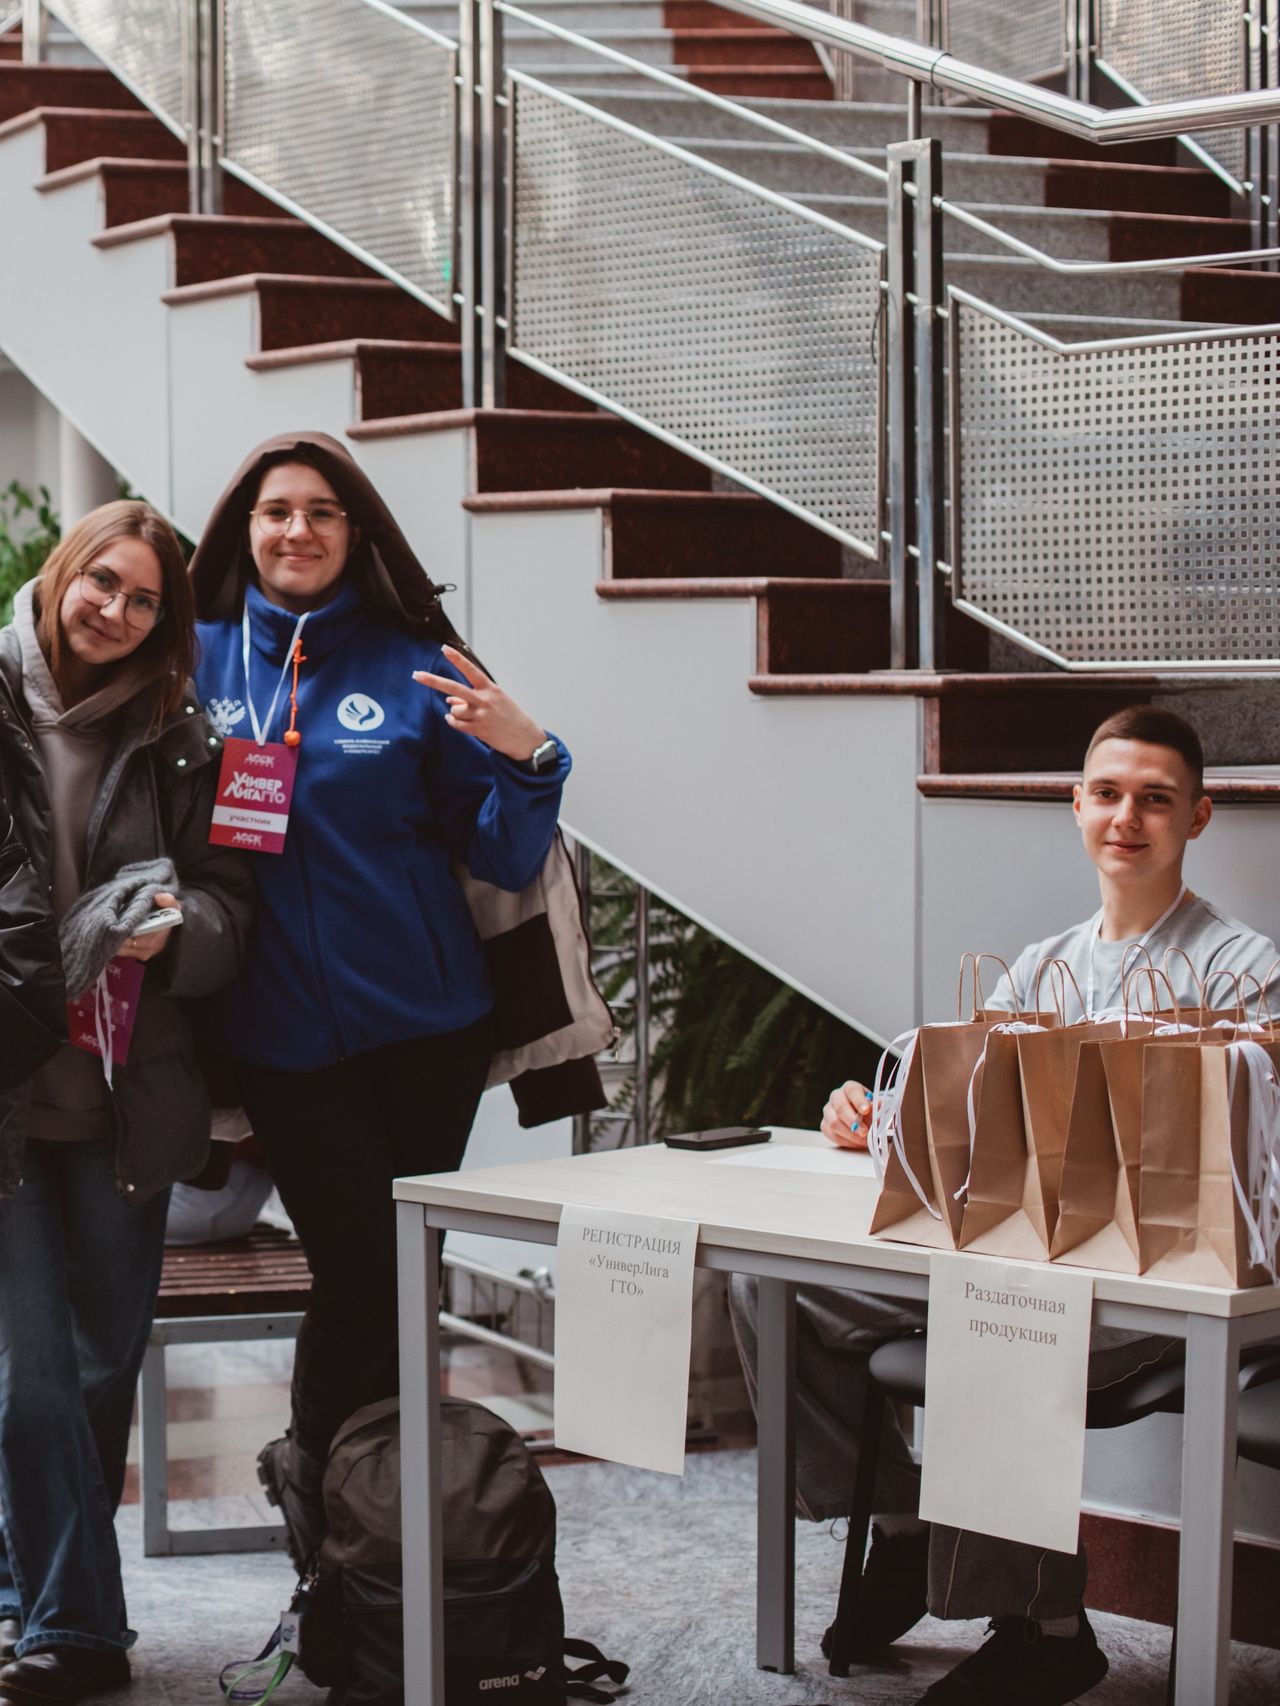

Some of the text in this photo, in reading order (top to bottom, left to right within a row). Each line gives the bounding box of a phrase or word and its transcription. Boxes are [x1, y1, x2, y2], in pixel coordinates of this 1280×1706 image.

[228, 814, 272, 826] участник
[582, 1227, 681, 1255] РЕГИСТРАЦИЯ
[589, 1254, 669, 1279] «УниверЛига
[610, 1278, 644, 1296] ГТО»
[964, 1281, 1066, 1315] Раздаточная
[969, 1318, 1058, 1346] продукция
[479, 1674, 520, 1690] arena
